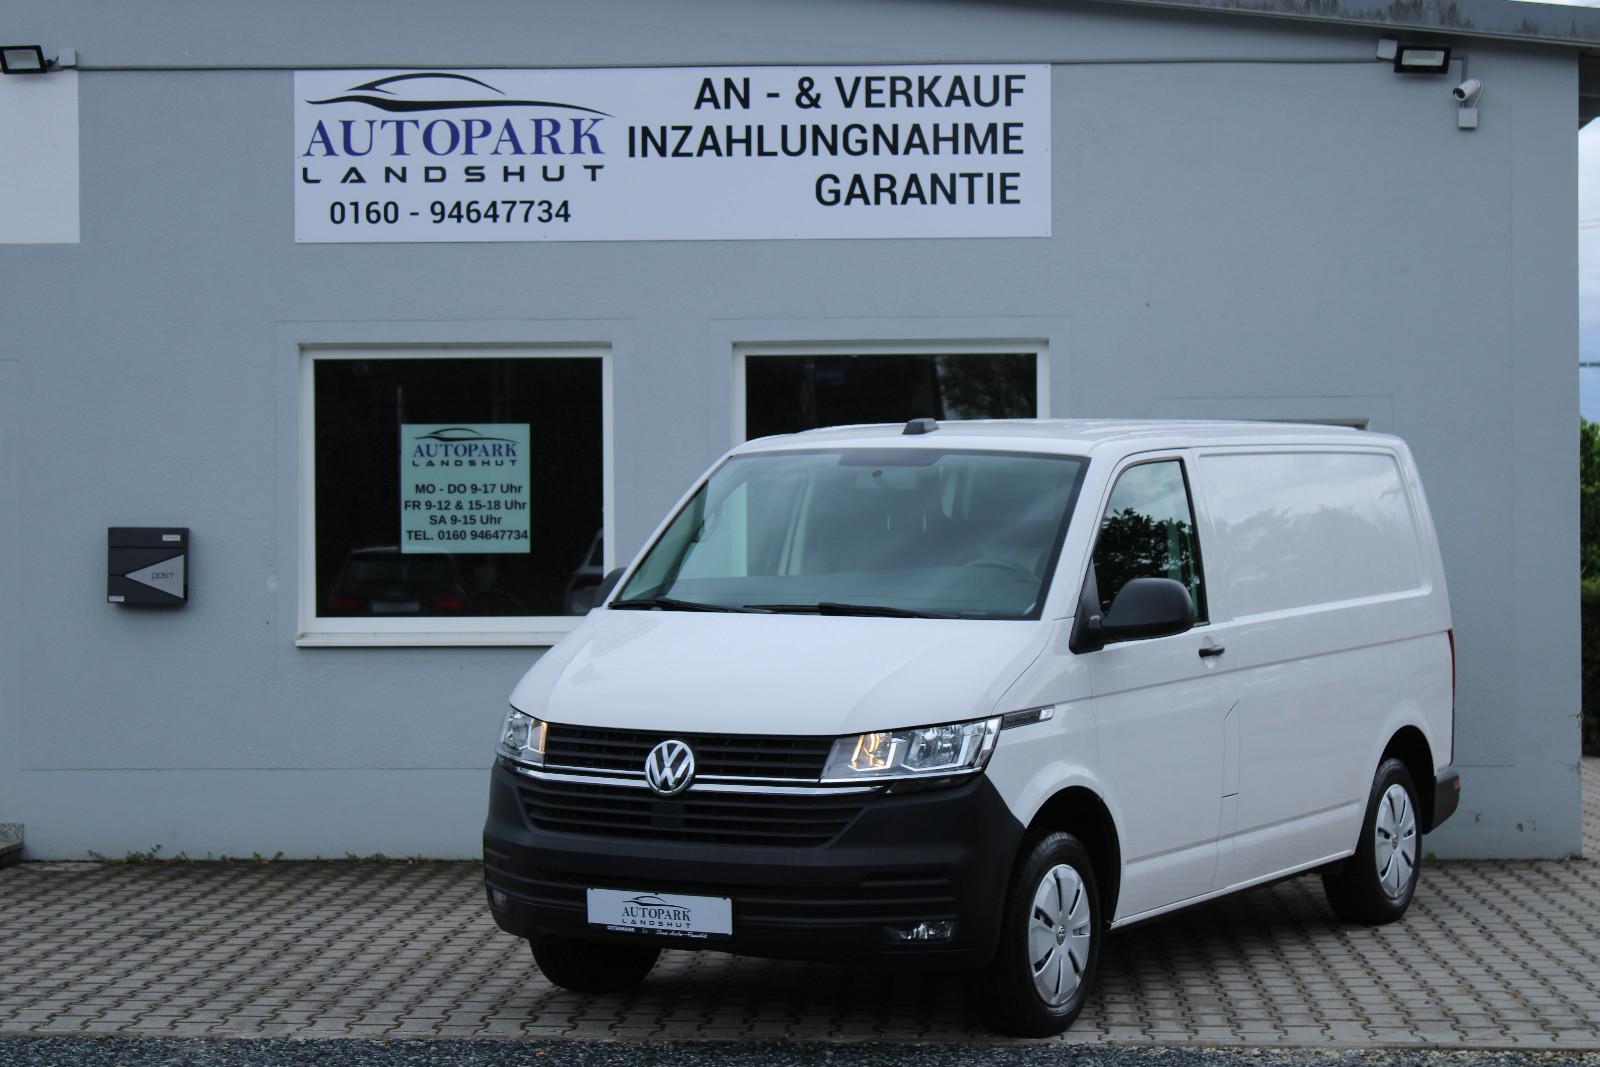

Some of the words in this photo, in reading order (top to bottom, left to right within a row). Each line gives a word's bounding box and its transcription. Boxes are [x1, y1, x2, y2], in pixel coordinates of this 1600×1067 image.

[694, 76, 751, 110] AN
[795, 76, 823, 109] &
[834, 74, 1026, 108] VERKAUF
[300, 117, 607, 157] AUTOPARK
[627, 122, 1025, 158] INZAHLUNGNAHME
[302, 164, 605, 184] LANDSHUT
[814, 172, 1021, 207] GARANTIE
[329, 200, 400, 225] 0160
[429, 199, 571, 224] 94647734
[413, 443, 517, 457] AUTOPARK
[412, 459, 517, 467] LANDSHUT
[415, 483, 436, 494] MO
[447, 483, 467, 494] DO
[470, 483, 497, 494] 9-17
[500, 483, 523, 494] Uhr
[404, 500, 421, 511] FR
[425, 500, 451, 511] 9-12
[454, 500, 464, 510] &
[467, 500, 501, 511] 15-18
[504, 499, 527, 510] Uhr
[429, 514, 447, 525] SA
[450, 514, 477, 525] 9-15
[480, 514, 503, 525] Uhr
[406, 530, 434, 541] TEL.
[437, 530, 467, 540] 0160
[470, 530, 528, 540] 94647734
[646, 740, 694, 795] VW
[622, 907, 691, 921] AUTOPARK
[622, 919, 692, 928] LANDSHUT
